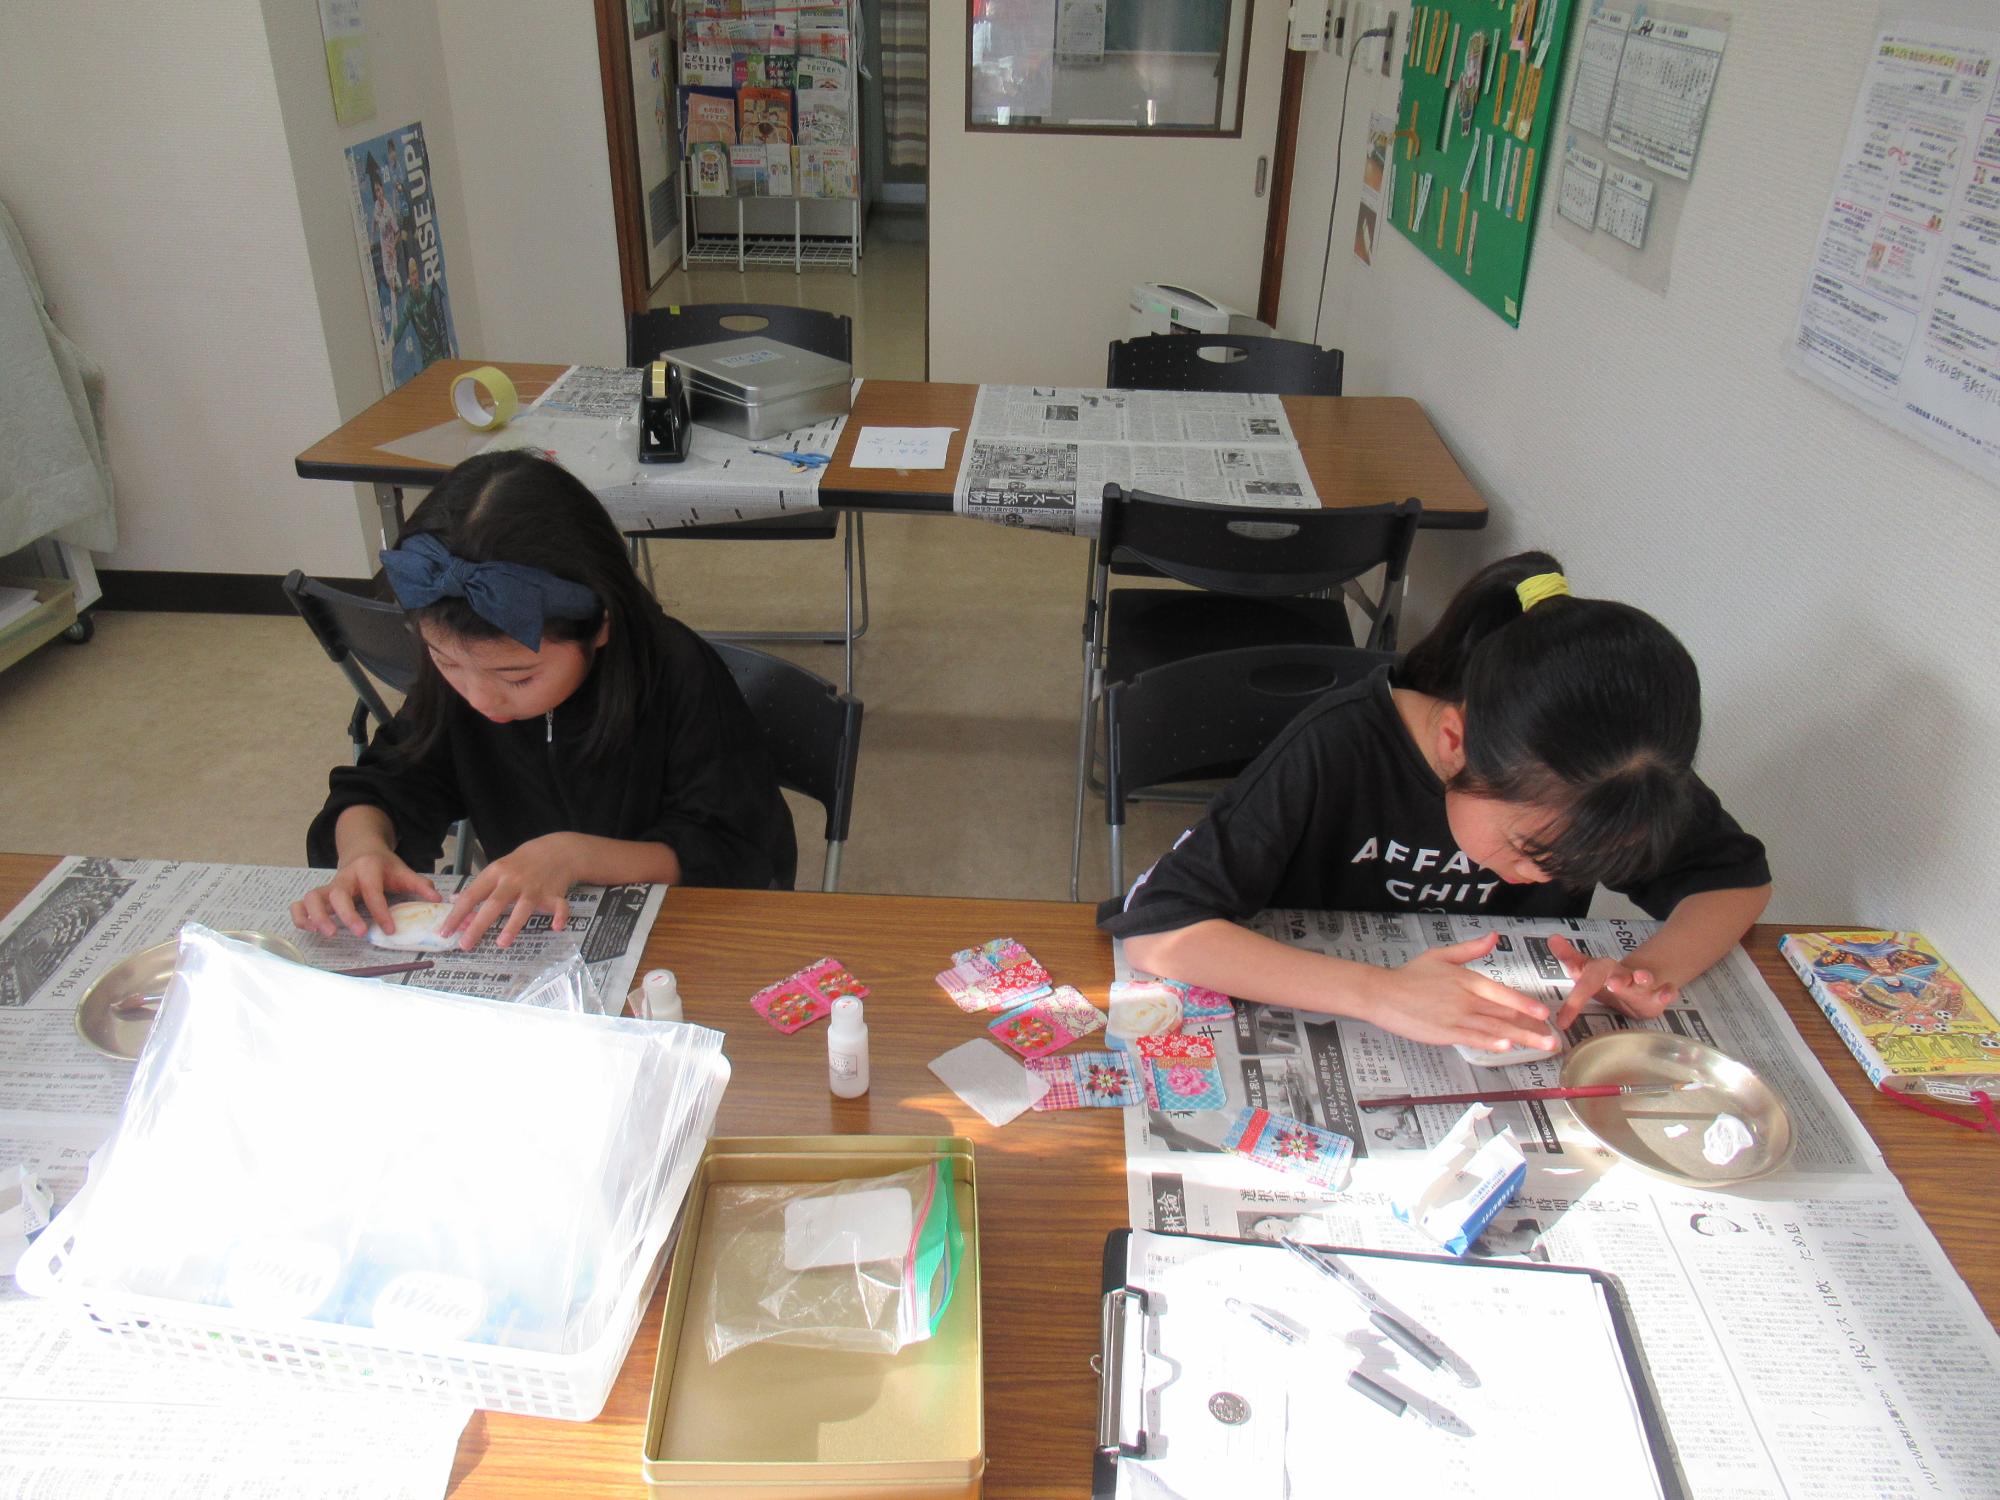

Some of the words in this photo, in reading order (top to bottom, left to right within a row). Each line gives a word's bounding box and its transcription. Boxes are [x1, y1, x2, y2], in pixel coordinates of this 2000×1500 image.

[401, 131, 427, 197] UP!
[413, 200, 442, 287] RISE
[1386, 879, 1500, 905] CHIT
[1247, 1068, 1263, 1108] 越し祝いに
[391, 1283, 474, 1322] White
